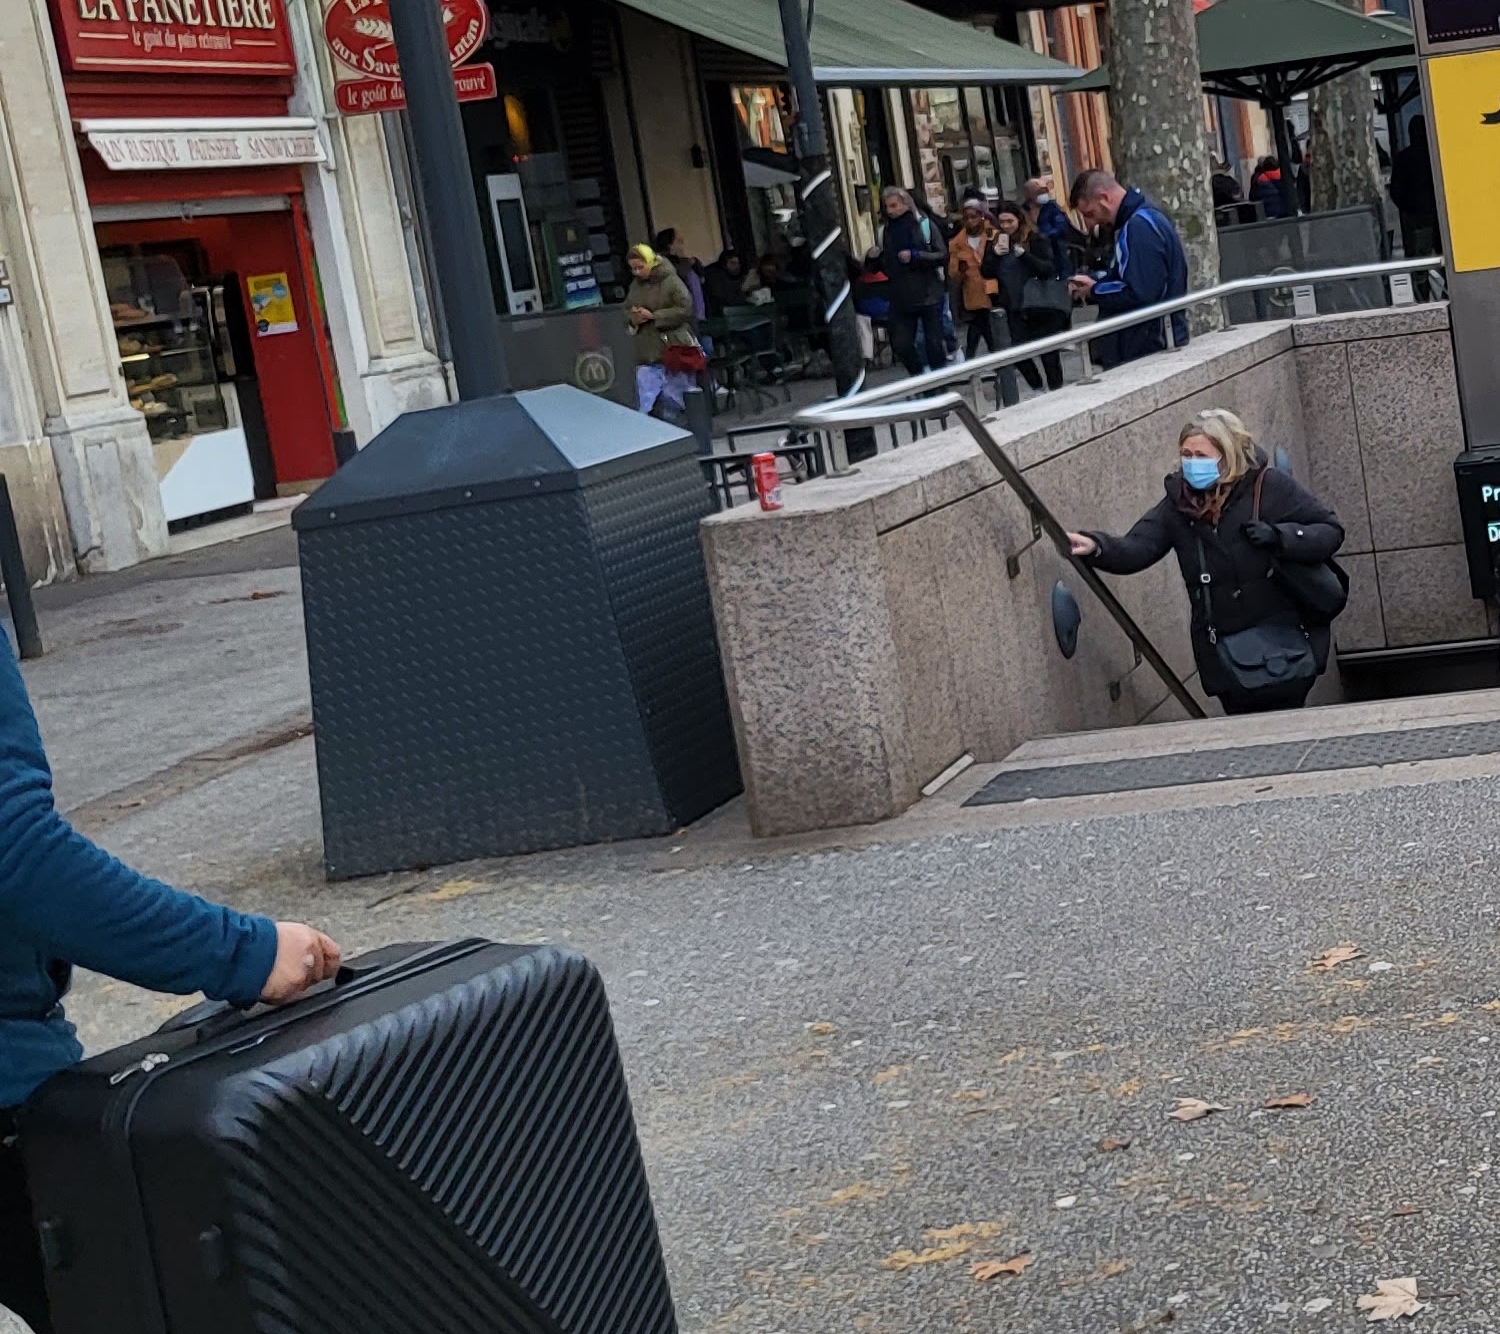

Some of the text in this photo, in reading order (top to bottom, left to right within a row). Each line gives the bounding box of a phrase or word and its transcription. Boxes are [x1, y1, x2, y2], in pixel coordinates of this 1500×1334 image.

[332, 37, 359, 66] aux
[361, 47, 400, 75] Save
[347, 87, 358, 106] le
[361, 85, 387, 109] goût
